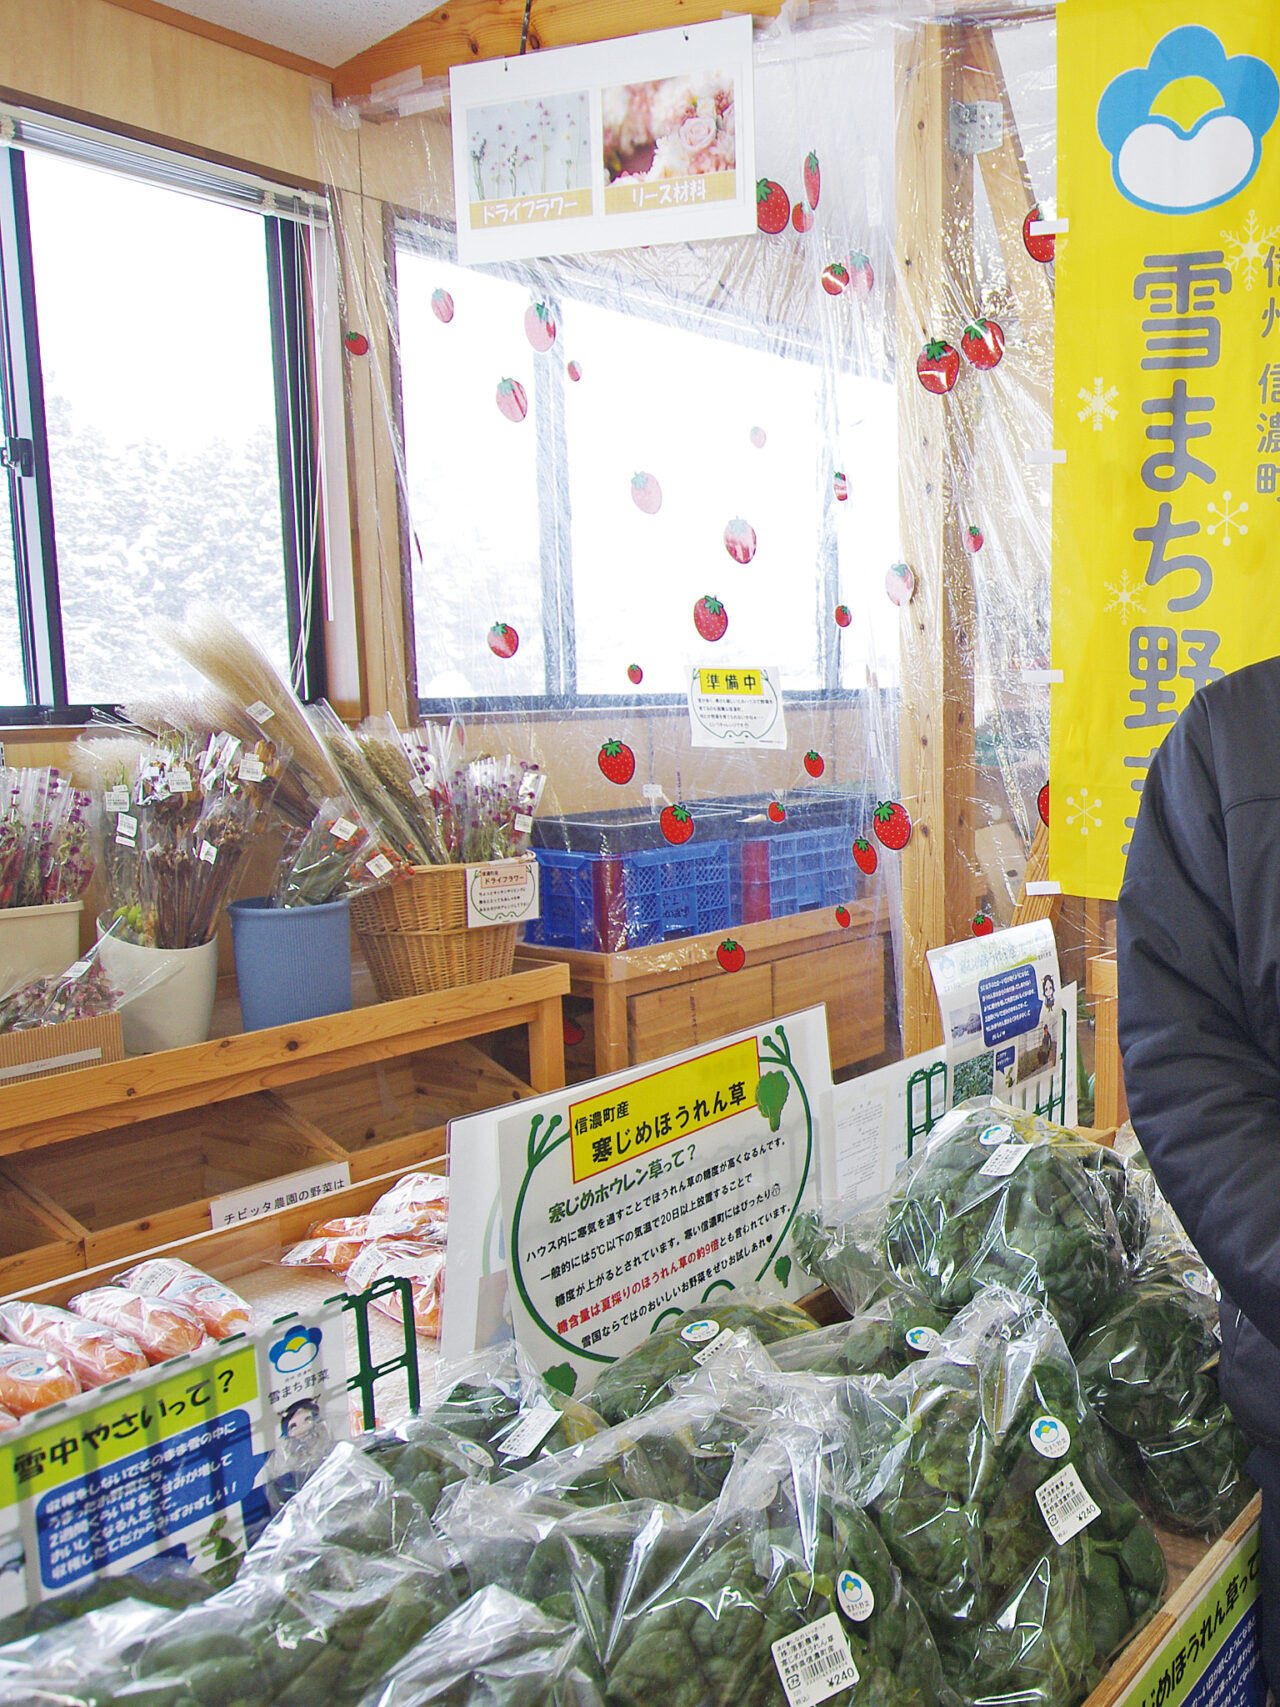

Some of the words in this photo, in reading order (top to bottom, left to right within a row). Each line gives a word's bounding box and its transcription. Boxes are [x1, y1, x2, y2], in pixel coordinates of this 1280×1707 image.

[631, 178, 707, 207] リース材料
[482, 196, 578, 226] ドライフラワー
[1121, 250, 1234, 856] 雪まち野
[705, 673, 757, 691] 準備中
[484, 874, 525, 886] ドライフラワー
[574, 1101, 631, 1136] 信濃町産
[591, 1081, 747, 1163] 寒じめほうれん草
[223, 1177, 346, 1226] チビッタ農園の野菜は
[267, 1368, 330, 1405] 雪まち野菜
[13, 1369, 236, 1485] 雪中やさいって？
[1076, 1504, 1097, 1521] ¥240
[826, 1667, 855, 1688] ¥240
